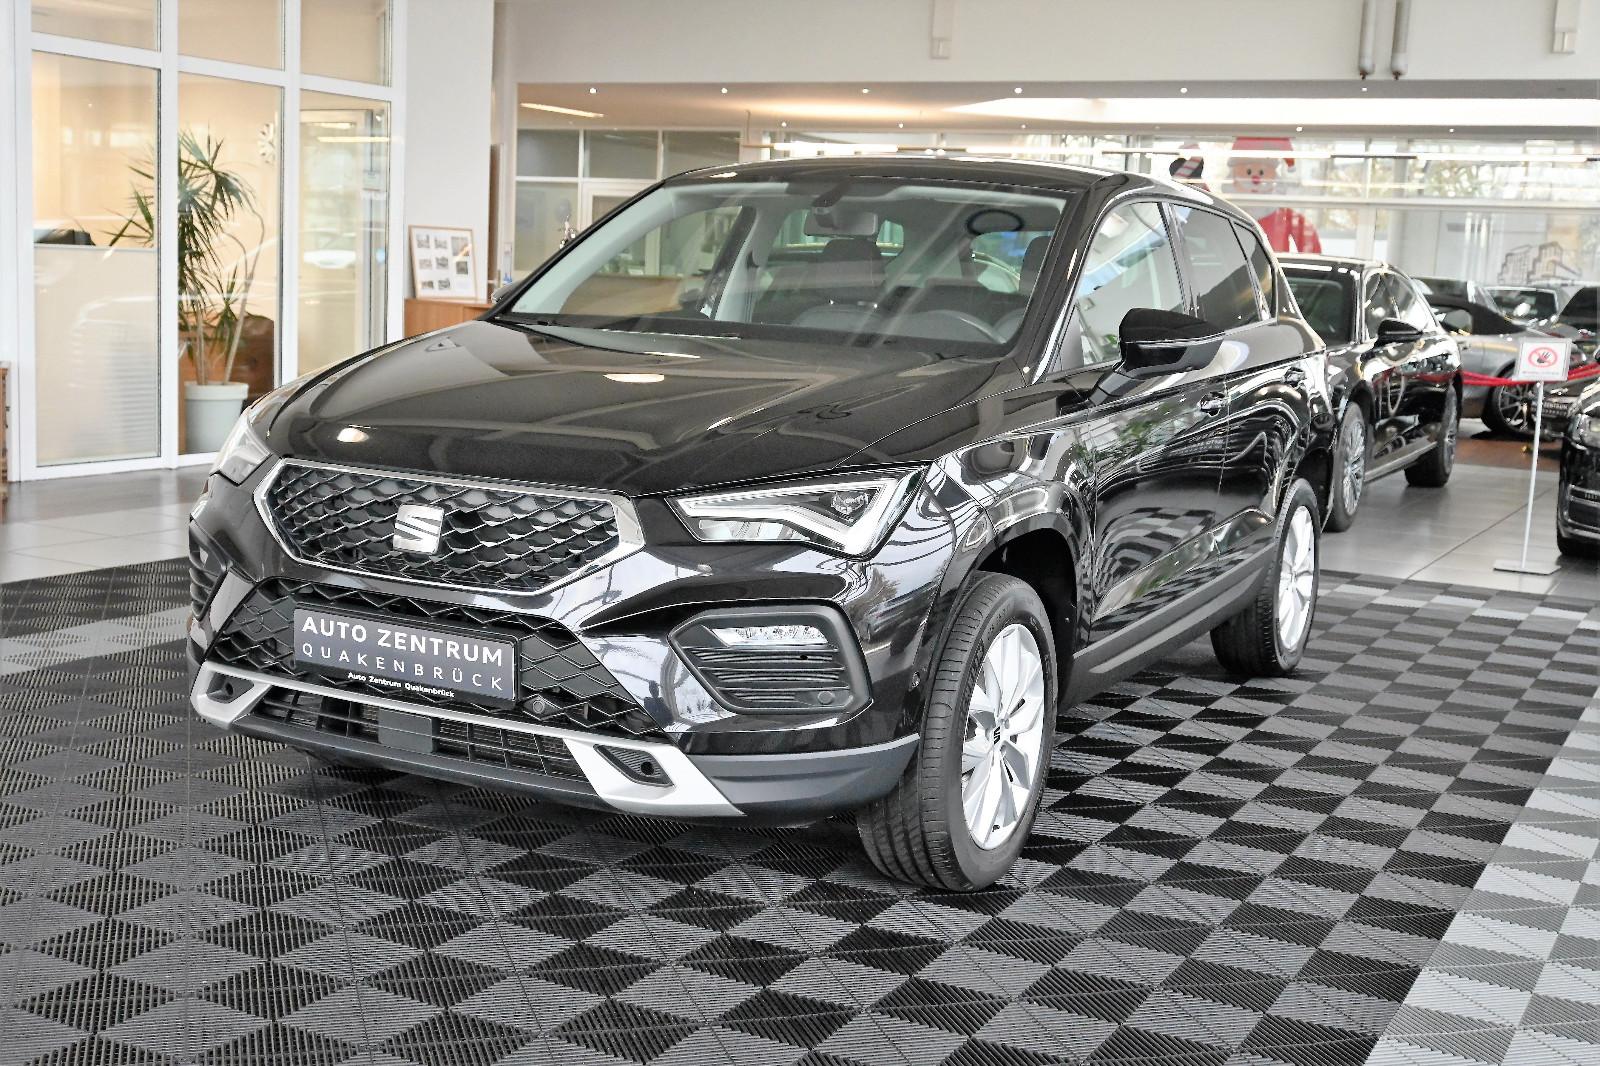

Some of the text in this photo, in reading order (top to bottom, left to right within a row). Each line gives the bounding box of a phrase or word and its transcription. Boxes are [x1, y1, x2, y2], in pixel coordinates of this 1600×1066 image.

[301, 616, 502, 666] AUTO ZENTRUM
[302, 643, 502, 690] QUAKENBRÜCK
[348, 672, 454, 697] Auto Zentrum Quakenbrück
